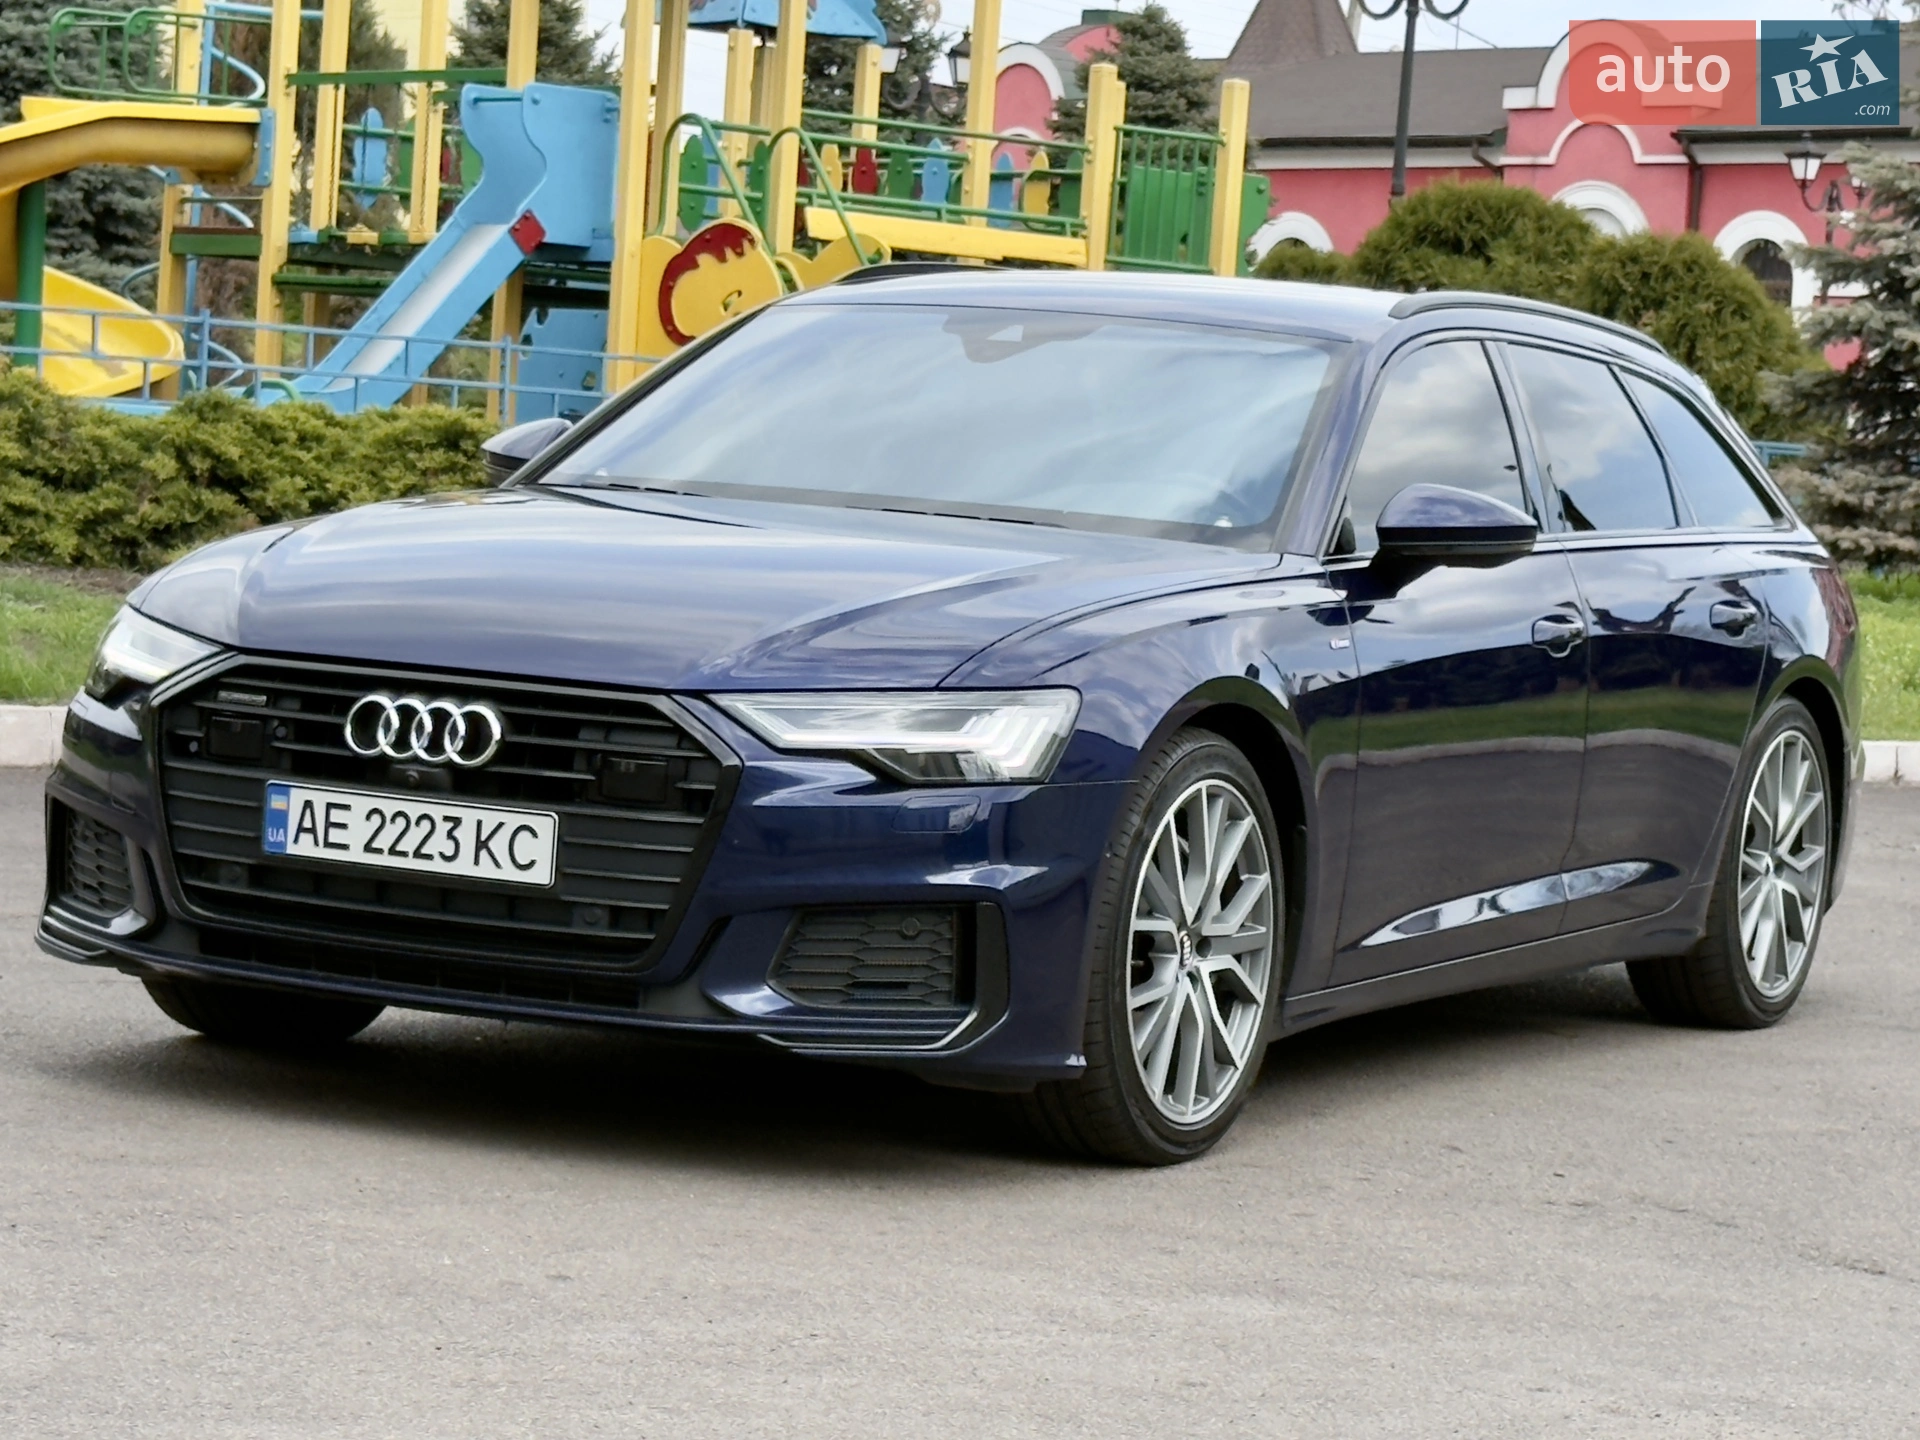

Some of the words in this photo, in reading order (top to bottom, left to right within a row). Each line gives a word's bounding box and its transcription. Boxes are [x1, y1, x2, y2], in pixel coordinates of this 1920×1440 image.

[268, 827, 286, 843] UA
[293, 799, 351, 851] AE
[363, 807, 463, 863] 2223
[473, 819, 539, 871] KC
